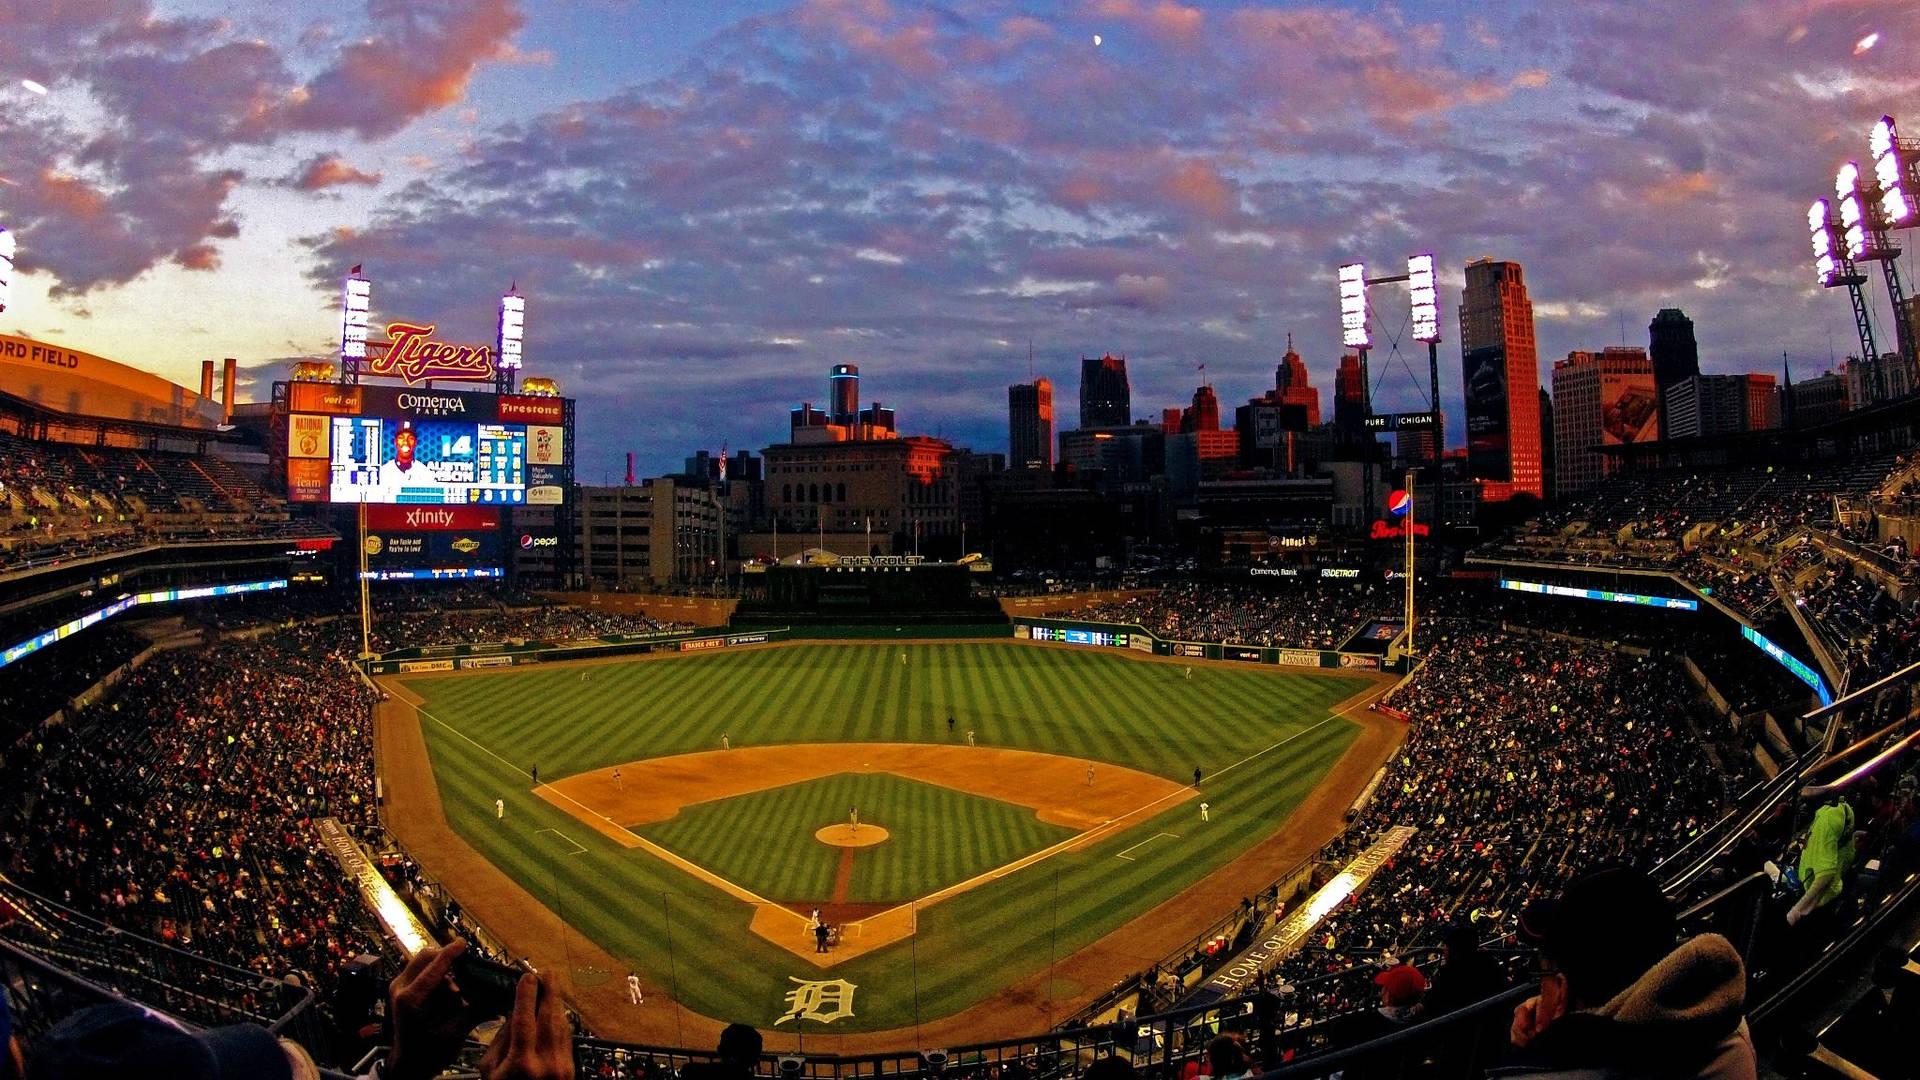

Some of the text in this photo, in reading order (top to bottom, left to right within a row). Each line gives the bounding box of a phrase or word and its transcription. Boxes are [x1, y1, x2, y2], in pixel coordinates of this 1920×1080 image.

[31, 346, 79, 369] FIELD
[371, 322, 493, 385] Tigers
[416, 408, 448, 416] PARK
[501, 403, 560, 415] Firestone
[1365, 418, 1385, 427] PURE
[441, 435, 473, 457] 14
[297, 477, 321, 488] Team
[406, 508, 454, 527] xfinity
[534, 536, 557, 548] pepsi
[840, 556, 925, 566] CHEVROLET
[1281, 568, 1298, 576] Bank
[1330, 569, 1360, 578] DETROIT
[332, 836, 357, 858] HOME
[1212, 951, 1269, 988] HOME
[1263, 934, 1289, 950] OF
